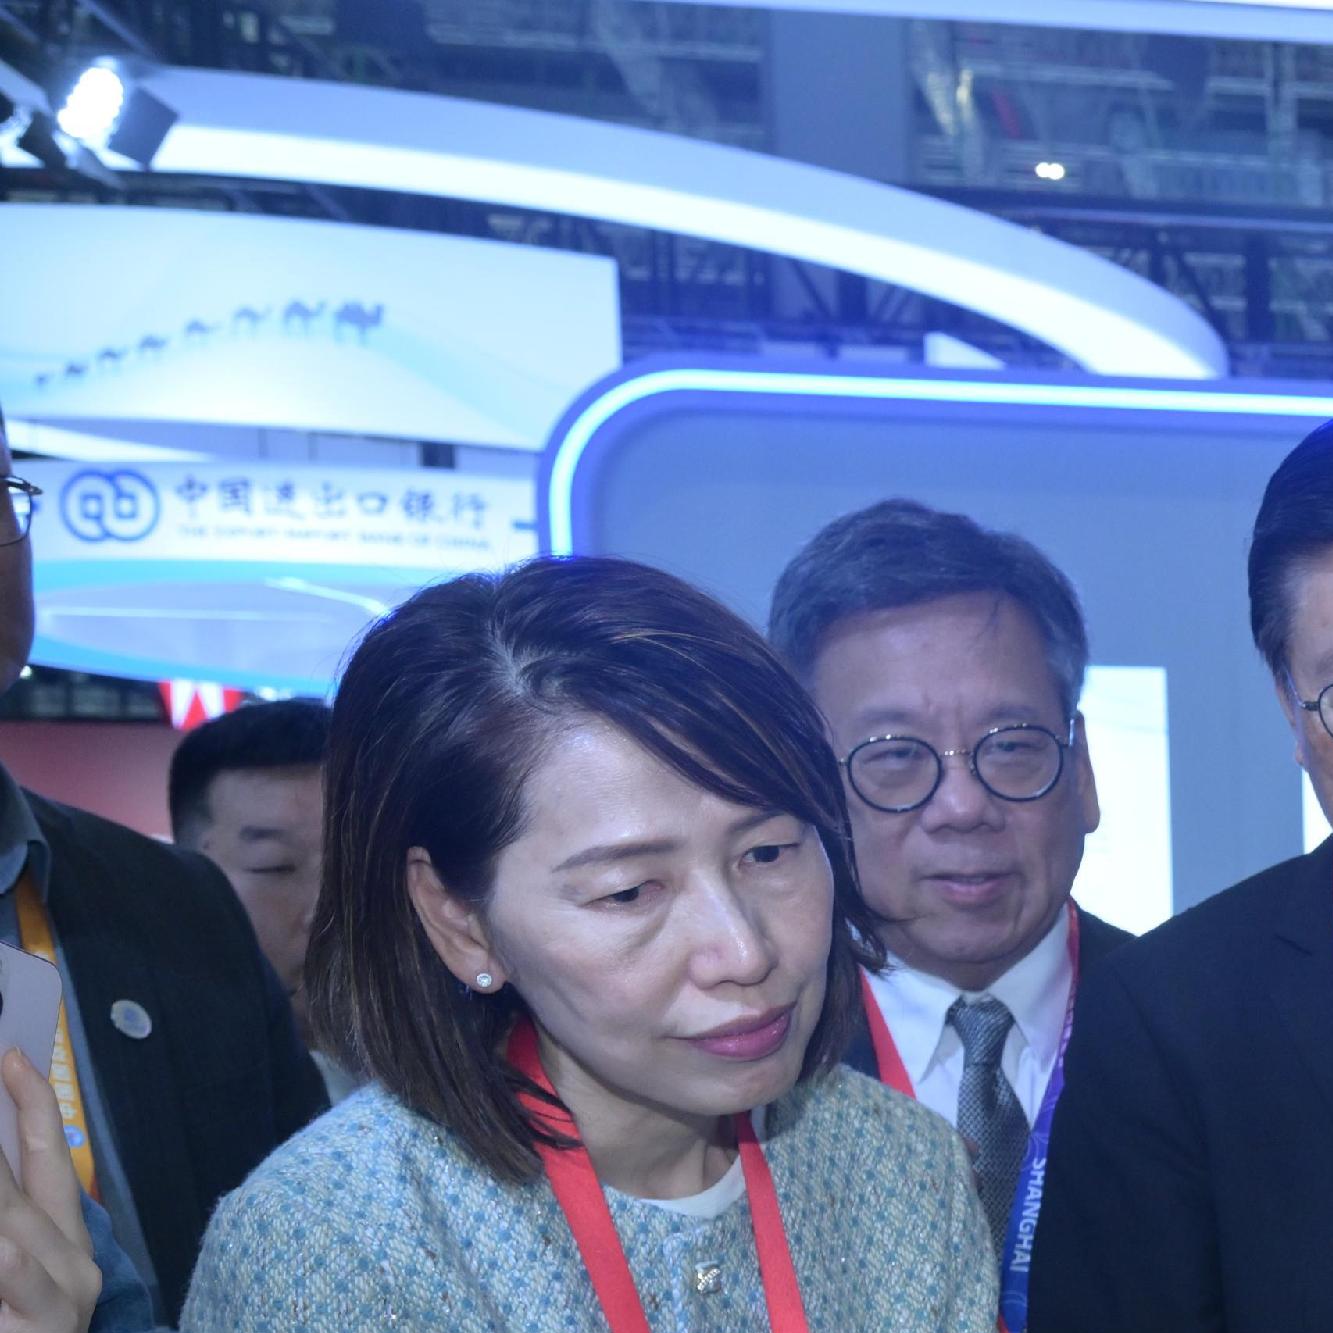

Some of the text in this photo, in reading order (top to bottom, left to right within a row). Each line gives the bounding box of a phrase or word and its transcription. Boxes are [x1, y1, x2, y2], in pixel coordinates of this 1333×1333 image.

[173, 474, 490, 530] 中国进出口银行
[1009, 1157, 1047, 1273] SHANGHAI
